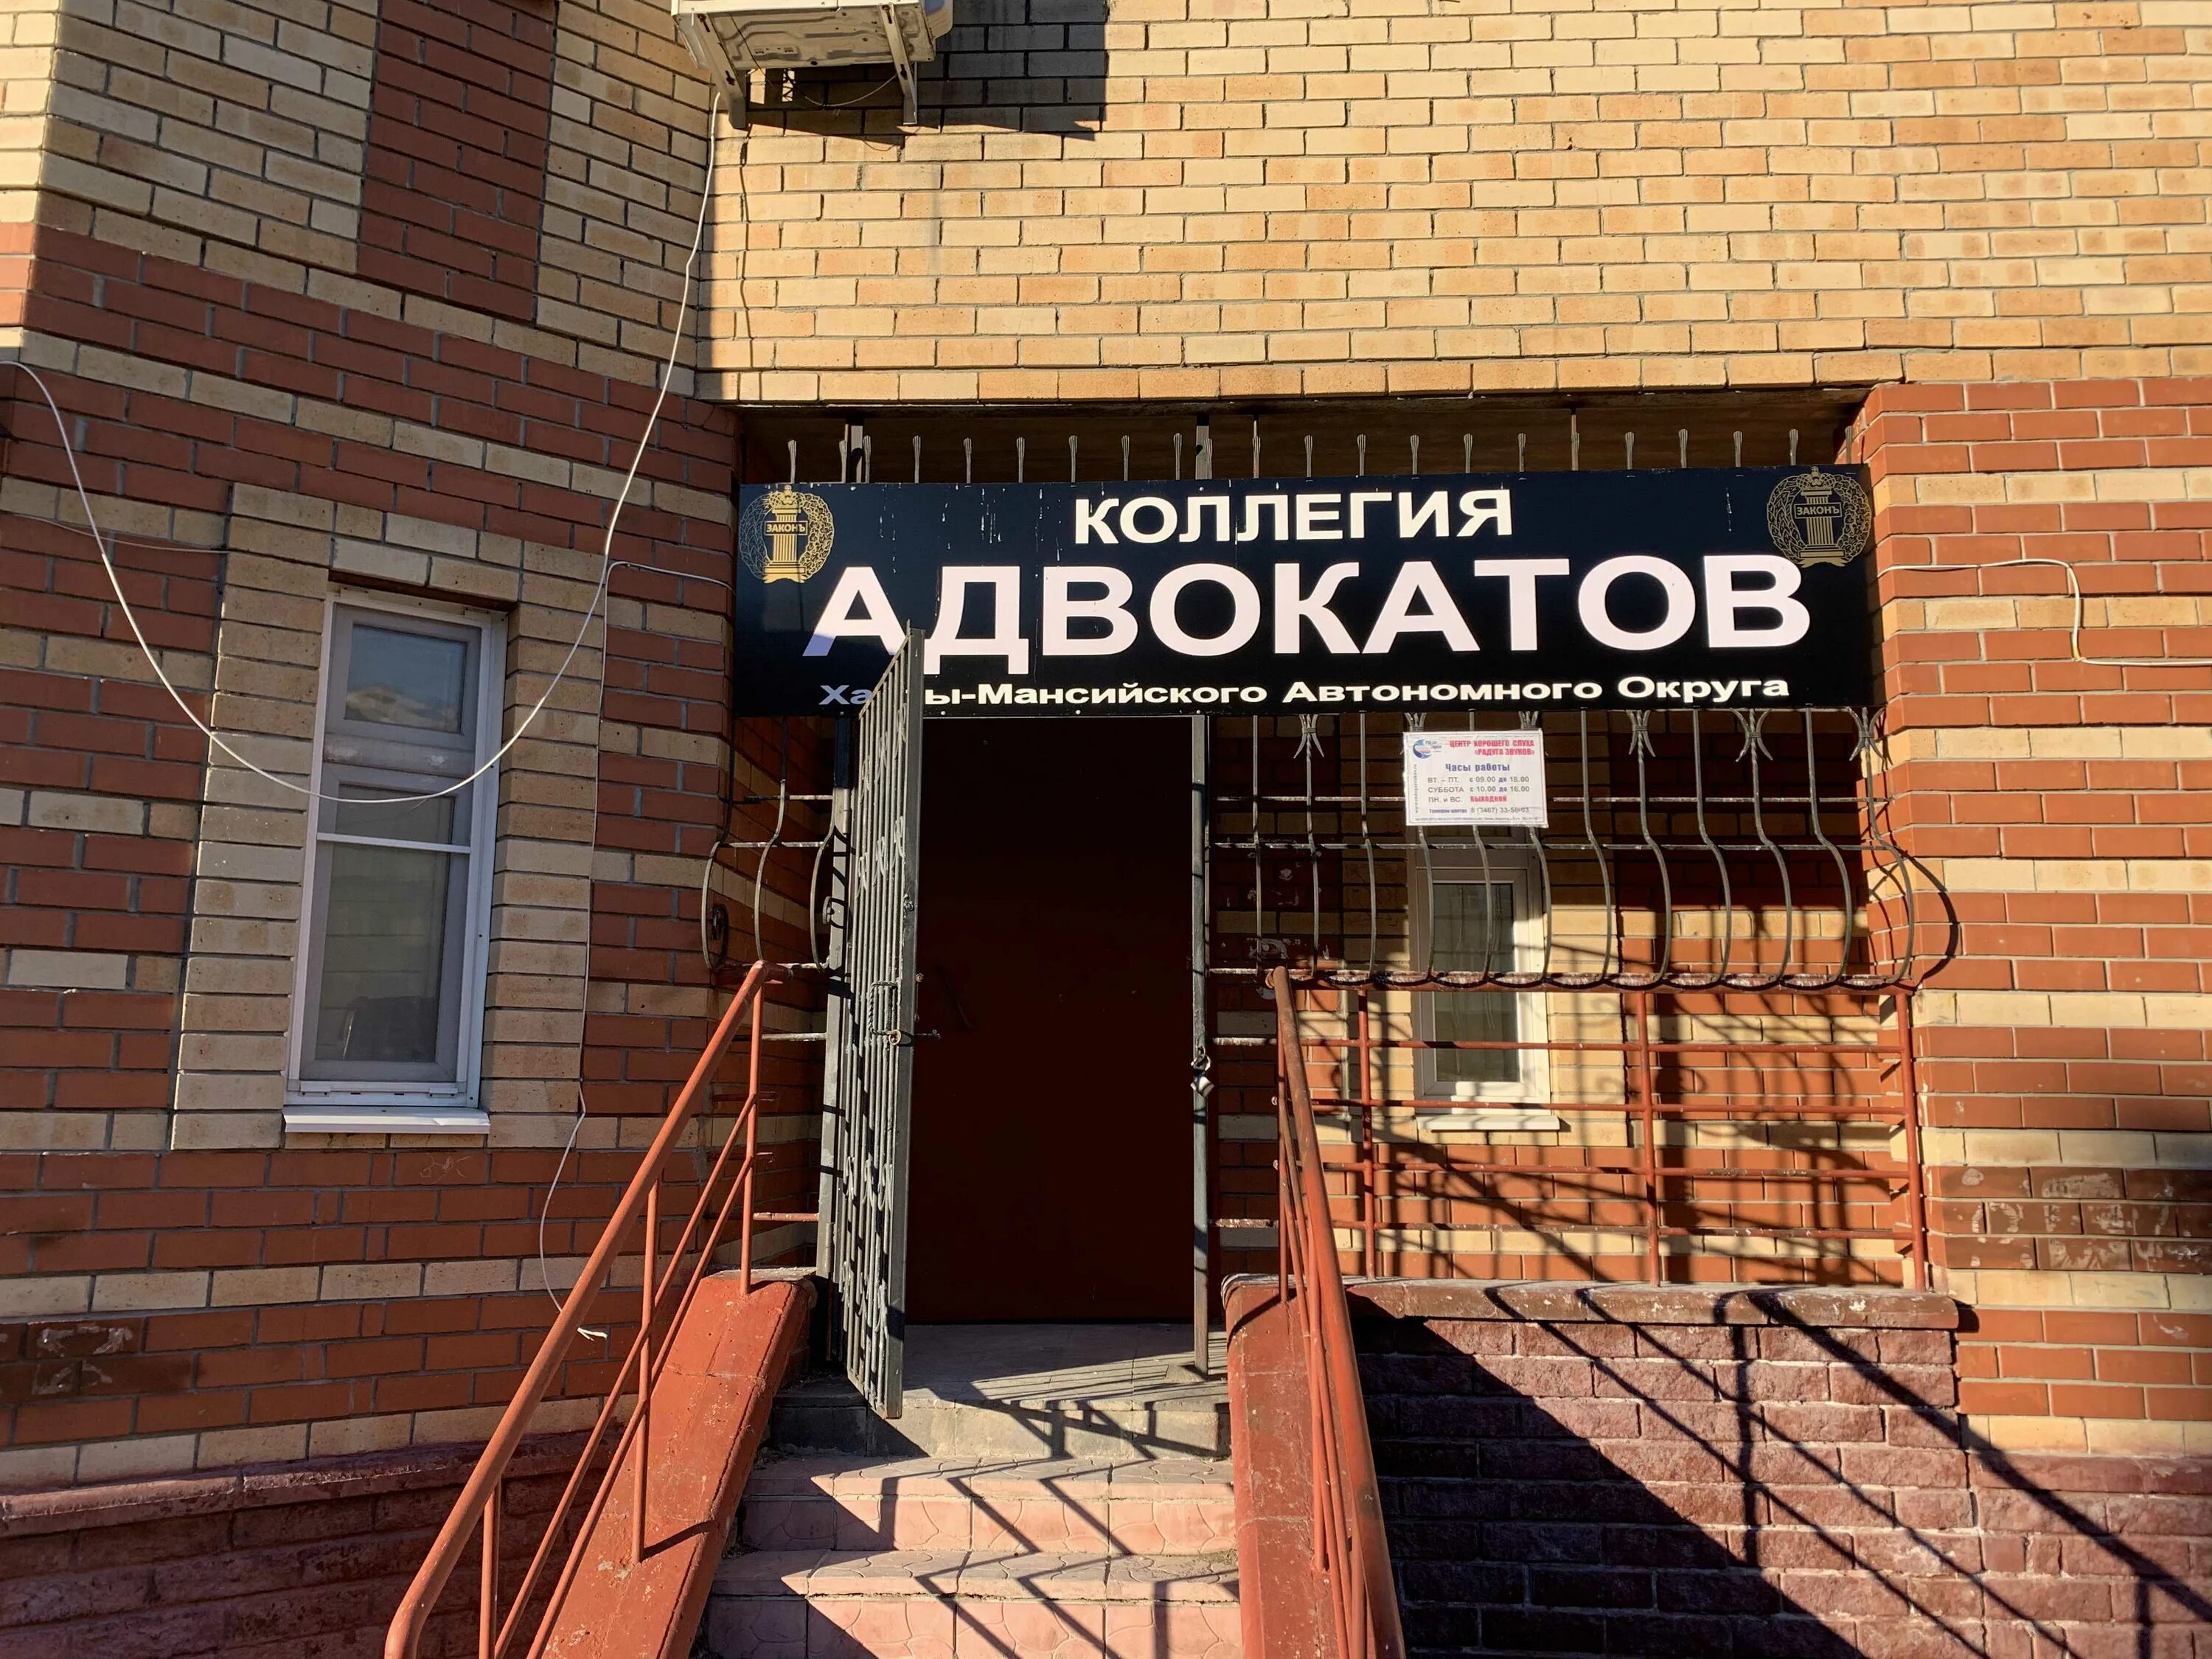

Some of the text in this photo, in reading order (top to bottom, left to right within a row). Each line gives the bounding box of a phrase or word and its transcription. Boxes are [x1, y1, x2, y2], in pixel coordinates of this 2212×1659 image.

[1076, 490, 1512, 545] КОЛЛЕГИЯ
[1796, 507, 1840, 515] ЗАКОНЪ
[766, 524, 805, 532] ЗАКОНЪ
[802, 555, 1809, 674] АДВОКАТОВ
[818, 677, 1789, 705] Хаы-Мансийского Автономного Округа
[1475, 764, 1510, 772] работы
